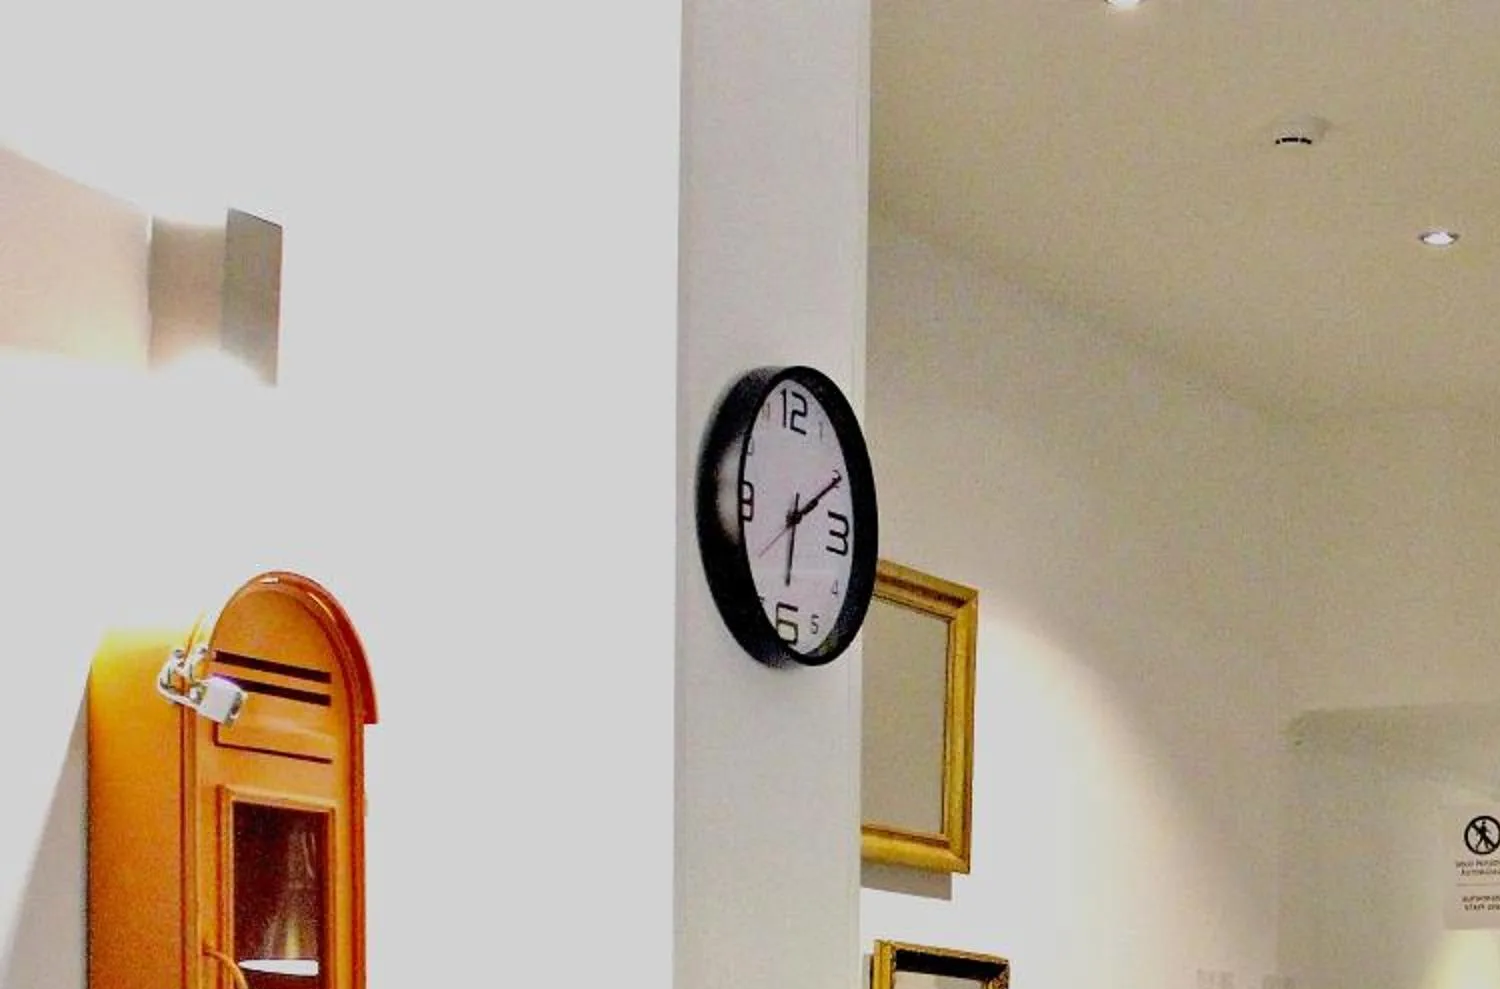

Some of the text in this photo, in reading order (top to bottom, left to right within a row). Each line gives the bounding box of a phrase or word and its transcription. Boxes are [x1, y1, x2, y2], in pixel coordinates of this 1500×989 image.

[780, 387, 808, 435] 12
[826, 510, 850, 557] 3
[776, 602, 798, 646] 6
[810, 614, 819, 635] 5
